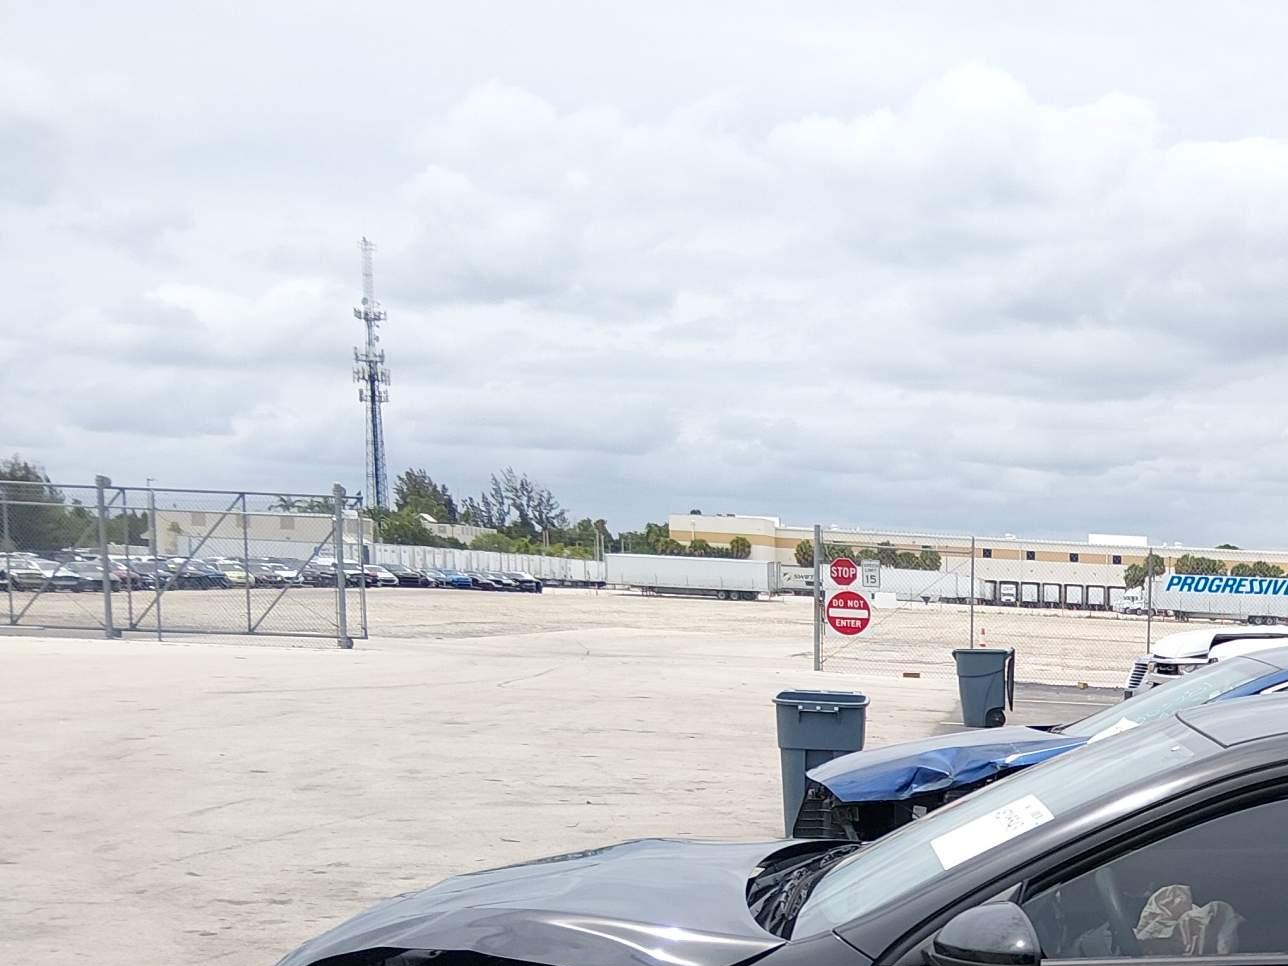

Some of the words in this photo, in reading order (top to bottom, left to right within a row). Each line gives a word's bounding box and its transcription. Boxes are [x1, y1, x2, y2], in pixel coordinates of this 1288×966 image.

[831, 566, 857, 578] STOP
[865, 575, 877, 584] 15
[832, 599, 844, 607] DO
[847, 600, 864, 608] NOT
[835, 619, 862, 628] ENTER
